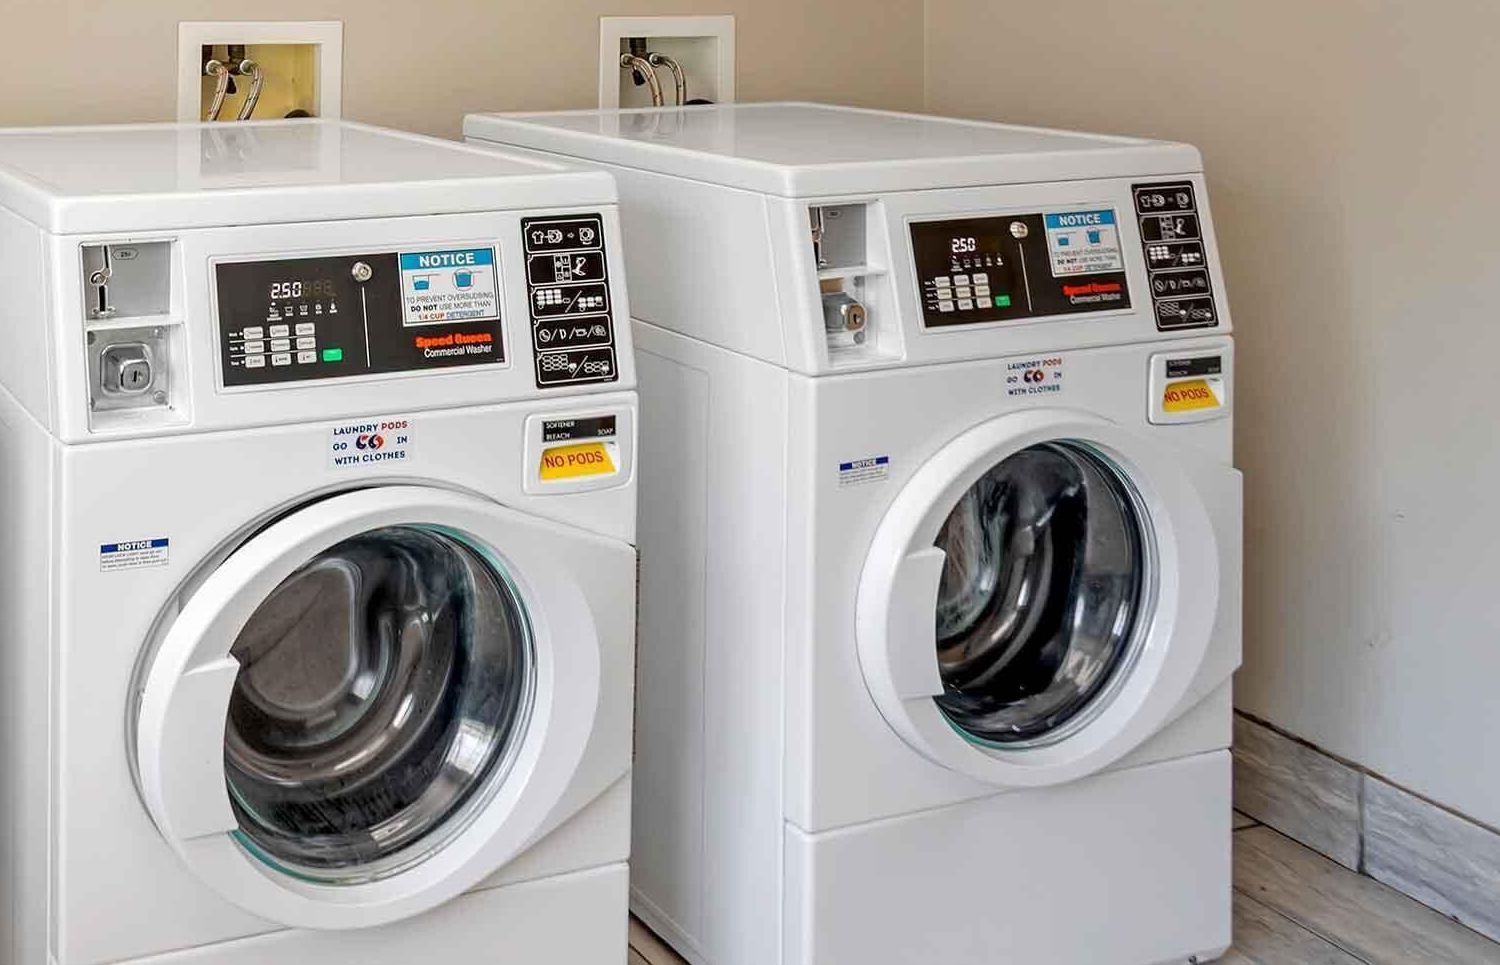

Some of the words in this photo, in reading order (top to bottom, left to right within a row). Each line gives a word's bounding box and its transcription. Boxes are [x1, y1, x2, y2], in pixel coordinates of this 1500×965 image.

[1059, 213, 1102, 227] NOTICE
[419, 252, 476, 268] NOTICE
[410, 305, 421, 313] DO
[423, 304, 438, 312] NOT
[415, 334, 454, 349] Speed
[454, 332, 493, 345] Queen
[423, 345, 466, 358] Commercial
[466, 343, 493, 354] Washer
[1164, 390, 1180, 404] NO
[1180, 387, 1210, 400] PODS
[333, 423, 379, 436] LAUNDRY
[380, 420, 409, 431] PODS
[332, 442, 348, 451] GO
[396, 435, 408, 445] IN
[334, 455, 360, 465] WITH
[362, 450, 406, 462] CLOTHES
[544, 454, 565, 469] NO
[567, 450, 605, 467] PODS
[117, 539, 152, 552] NOTICE
